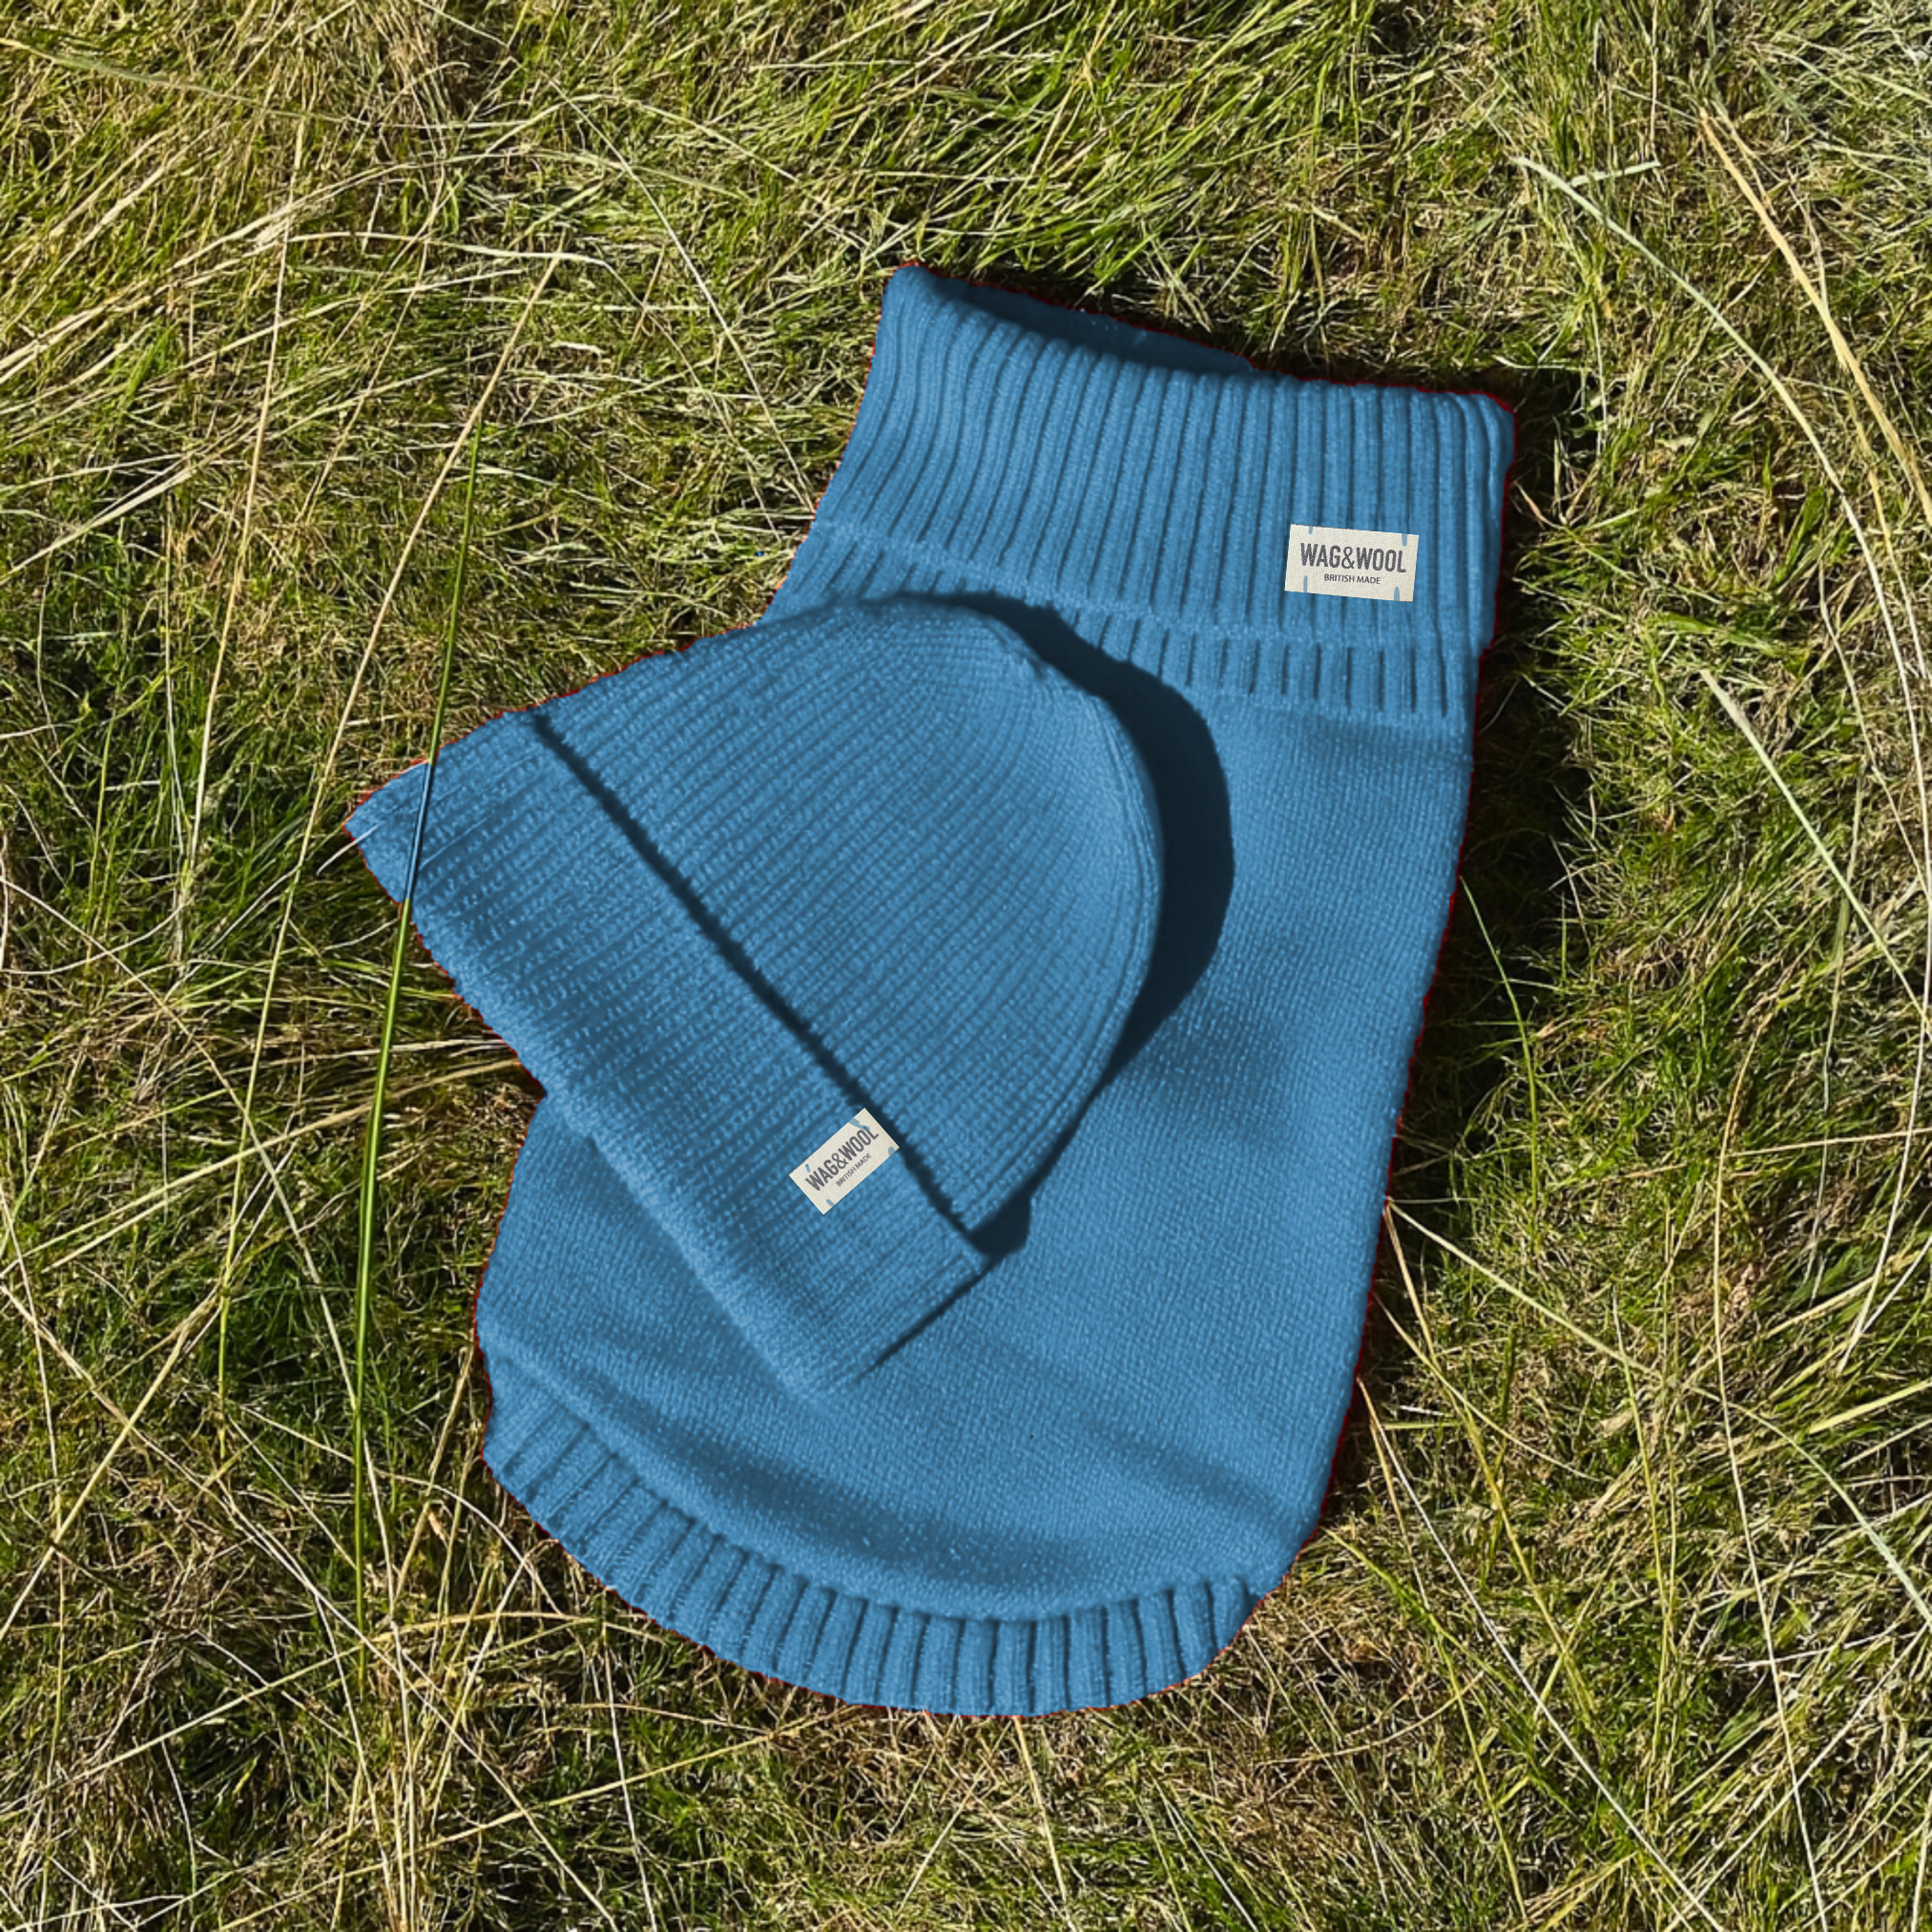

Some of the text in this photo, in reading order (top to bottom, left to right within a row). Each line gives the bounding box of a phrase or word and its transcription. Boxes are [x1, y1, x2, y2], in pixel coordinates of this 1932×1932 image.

[1300, 543, 1406, 572] WAG&WOOL
[1324, 573, 1381, 584] BRITISH MADE
[804, 1125, 879, 1191] WAG&WOOL
[836, 1153, 872, 1187] BRITISH MADE
